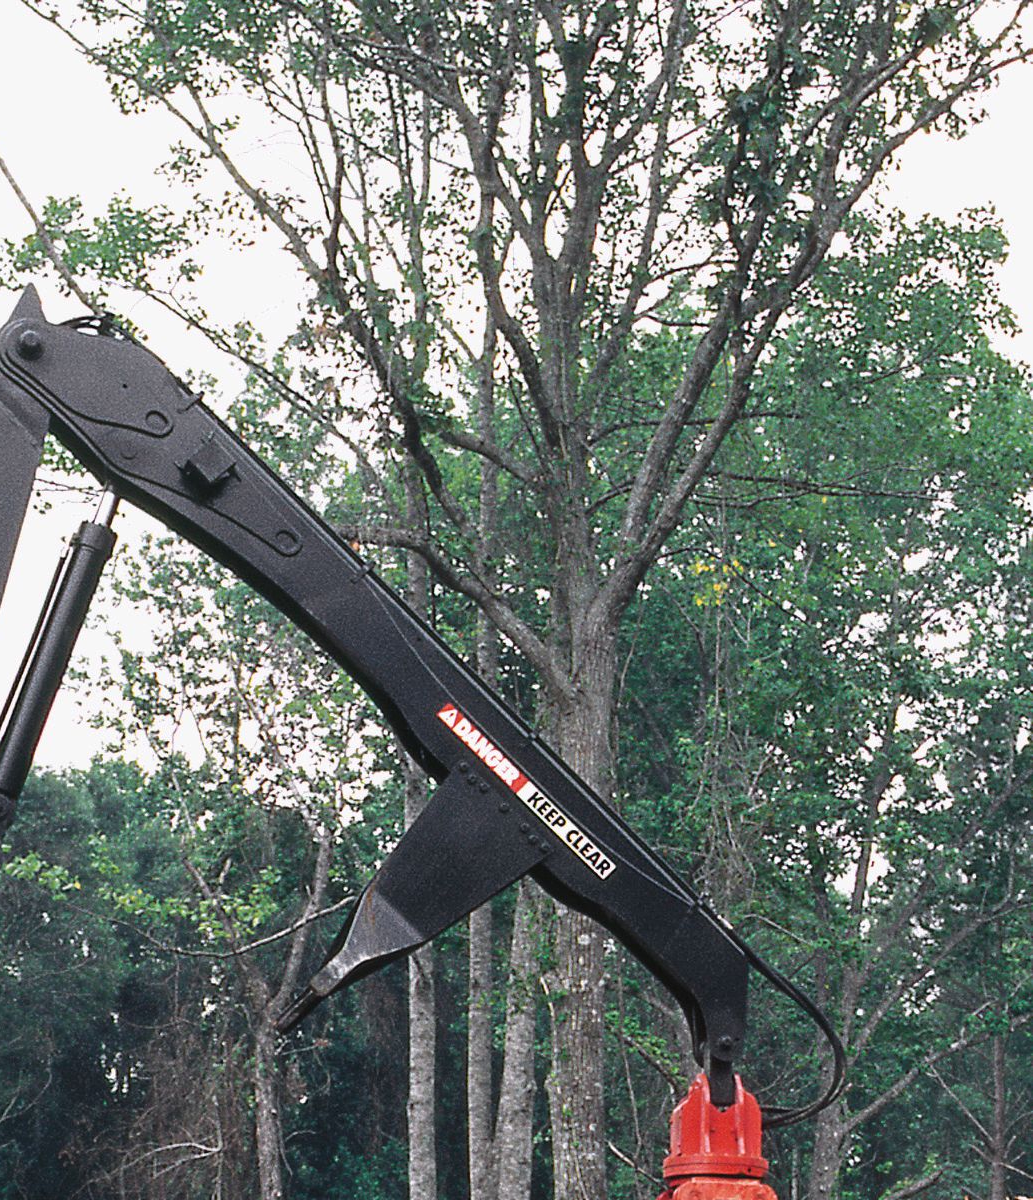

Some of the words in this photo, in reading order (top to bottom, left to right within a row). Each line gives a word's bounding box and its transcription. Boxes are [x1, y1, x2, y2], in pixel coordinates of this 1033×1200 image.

[452, 717, 521, 787] DANGER
[527, 791, 567, 828] KEEP
[566, 829, 611, 876] CLEAR
